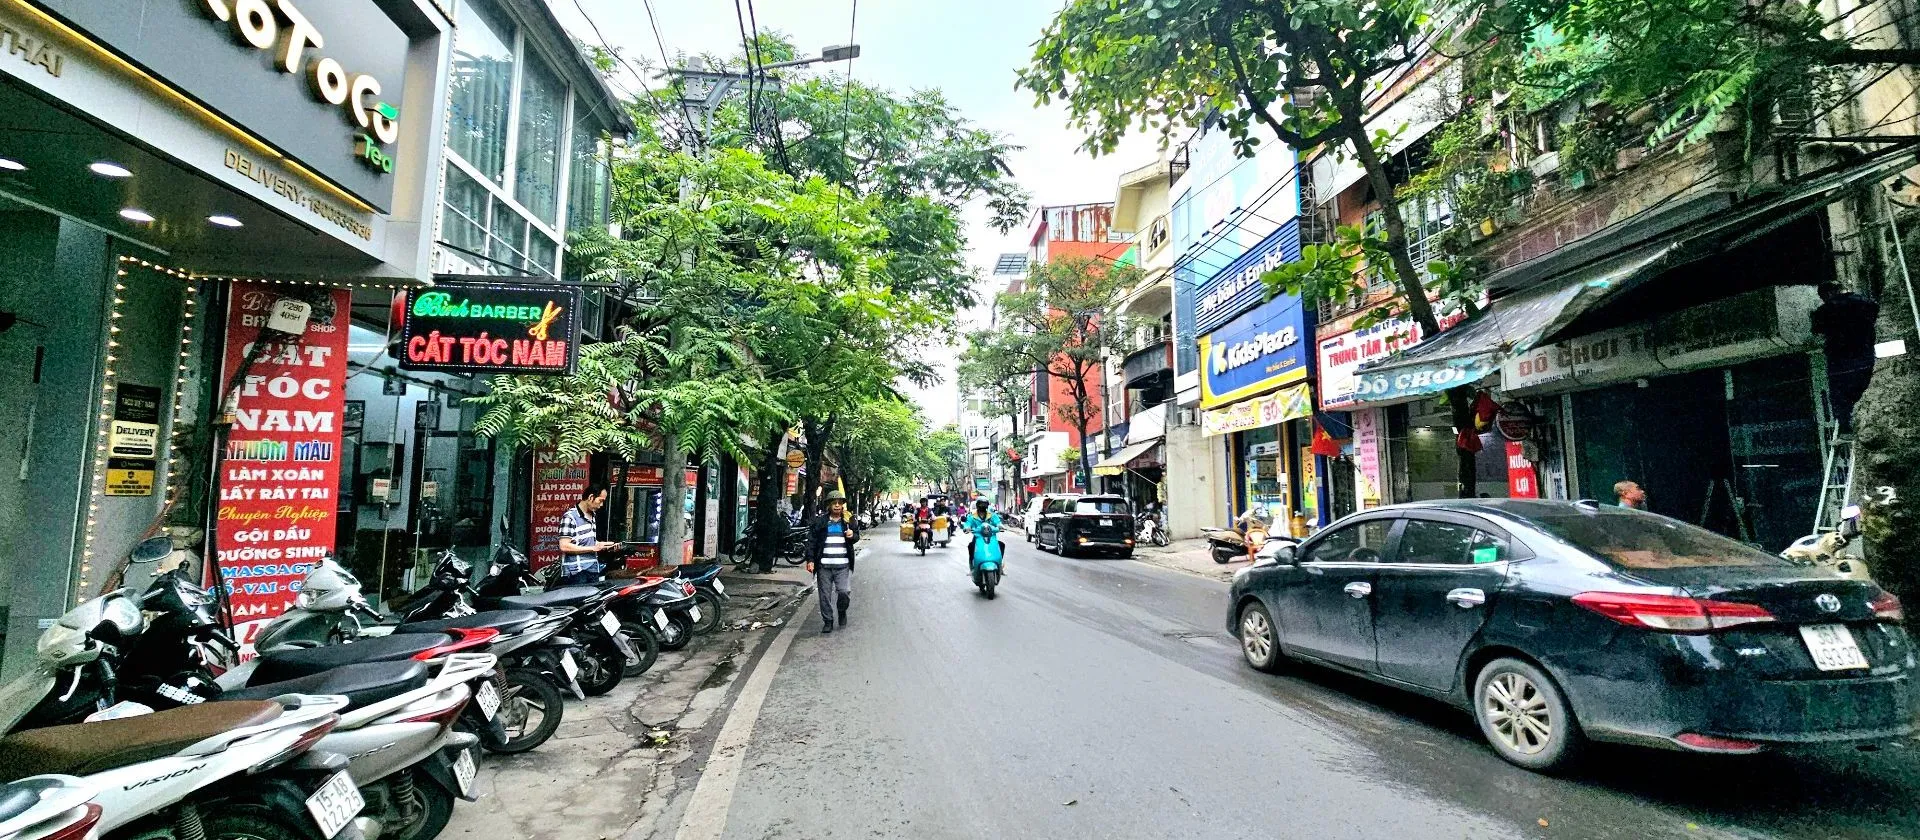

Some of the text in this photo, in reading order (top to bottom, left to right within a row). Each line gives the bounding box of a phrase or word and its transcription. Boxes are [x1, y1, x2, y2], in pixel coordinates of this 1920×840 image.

[200, 0, 398, 144] oToCo
[362, 133, 393, 174] Tea
[470, 304, 541, 319] BARBER
[311, 324, 336, 333] SHOP
[408, 330, 566, 366] CẮT TÓC NAM
[1328, 347, 1358, 368] TRUNG
[231, 409, 334, 433] NAM
[116, 425, 155, 437] DELIVERY
[229, 466, 324, 480] LÀM XOĂN
[220, 484, 329, 500] LẤY RÁY TAI
[217, 505, 329, 525] Chuyên Nghiệp
[233, 527, 269, 544] GỘI
[285, 546, 326, 558] SINH
[123, 763, 208, 791] VISION
